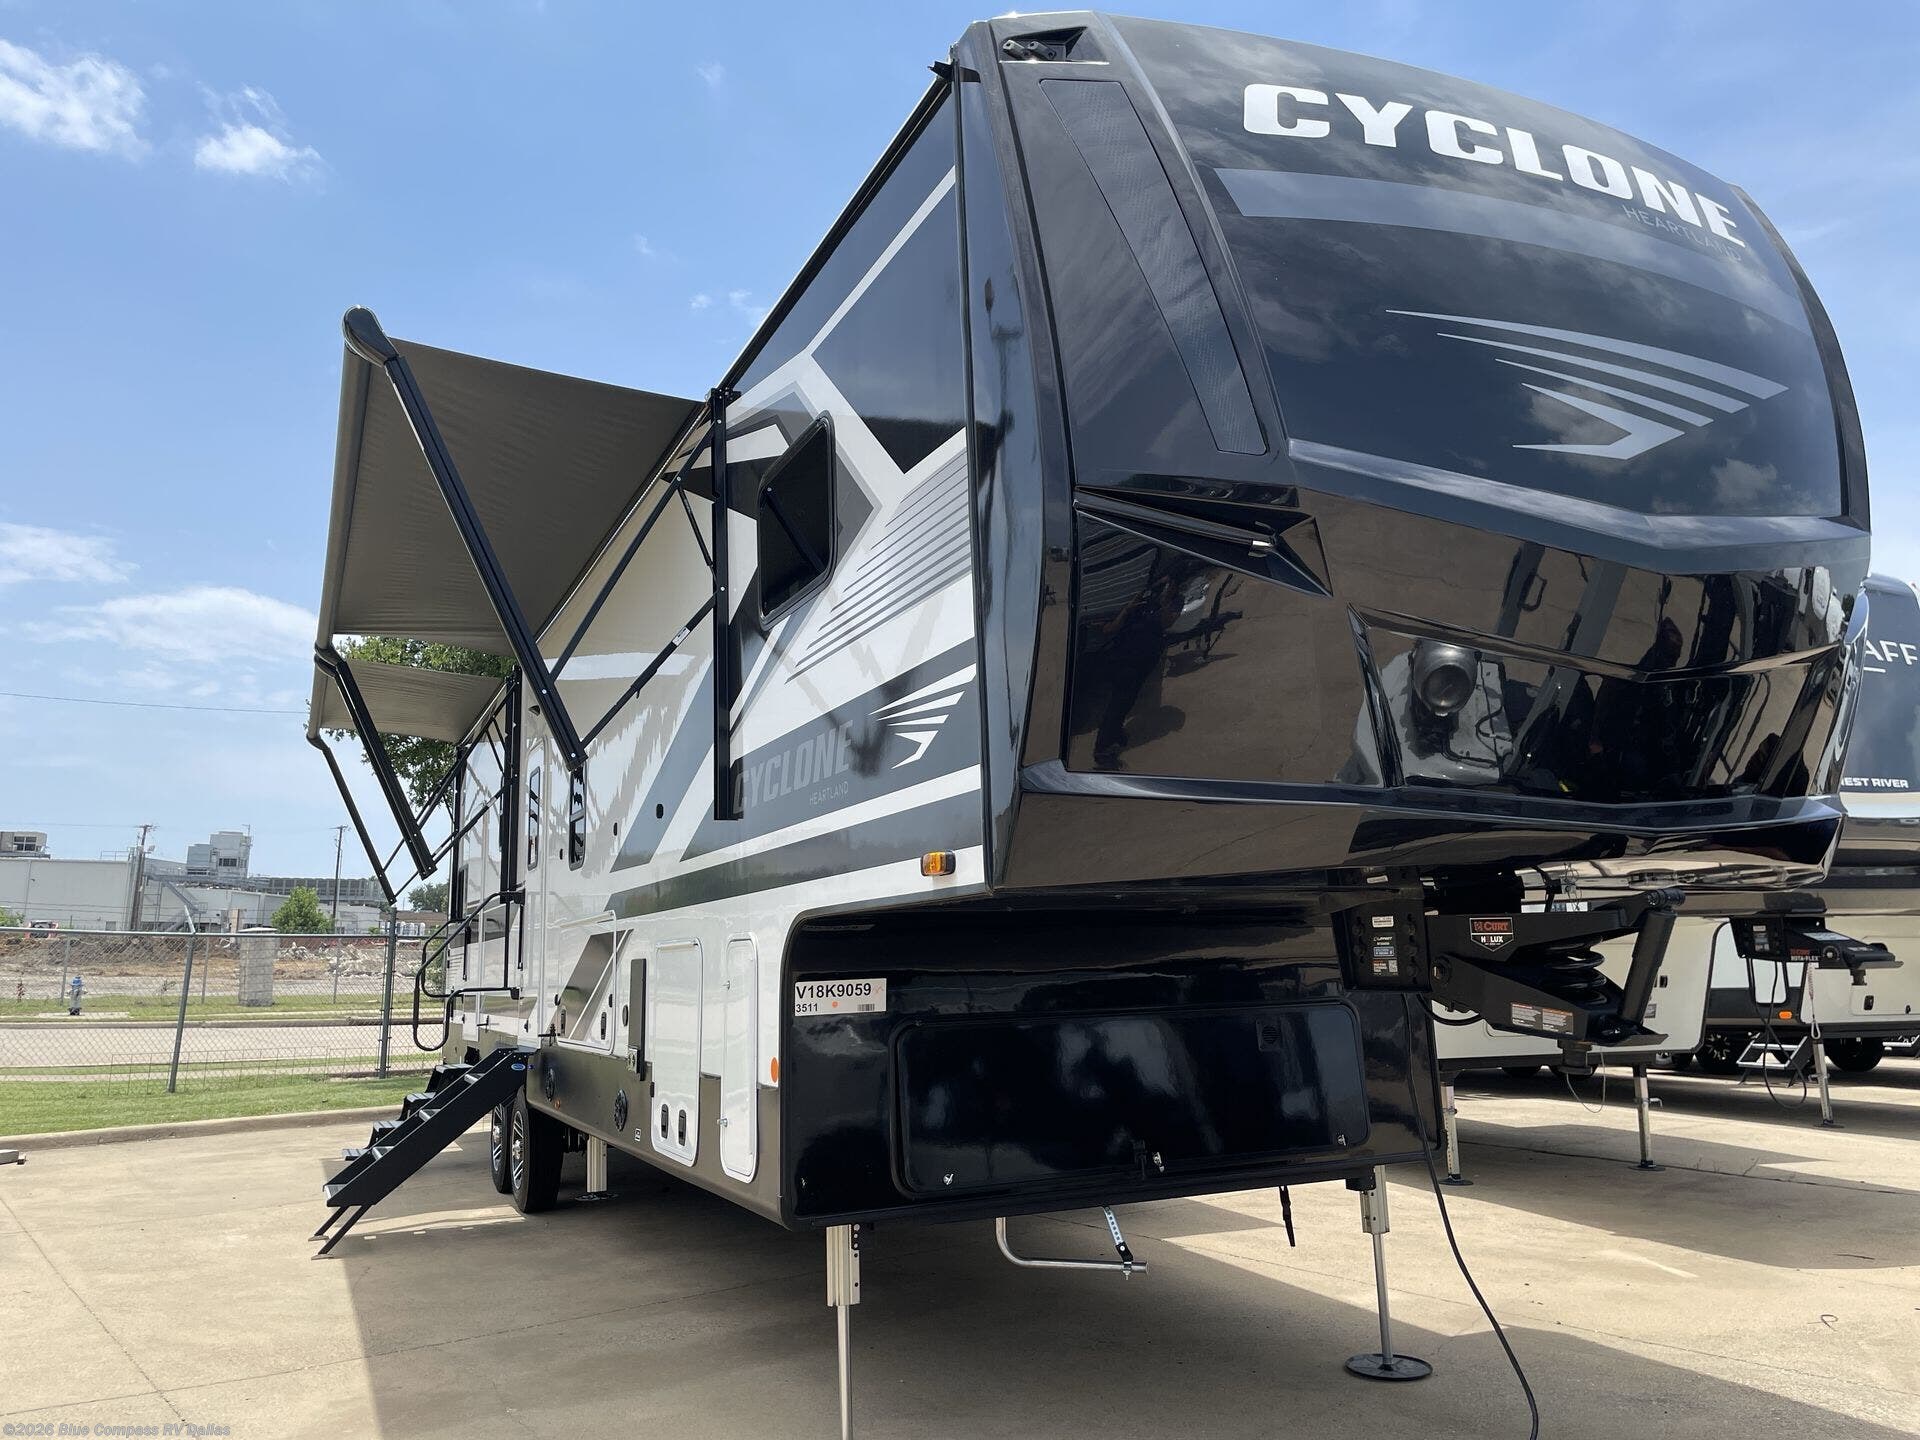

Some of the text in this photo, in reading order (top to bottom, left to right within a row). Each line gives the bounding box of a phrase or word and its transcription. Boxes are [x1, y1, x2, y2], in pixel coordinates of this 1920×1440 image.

[1243, 83, 1746, 248] CYCLONE
[1622, 203, 1742, 263] HEARTLAND
[732, 719, 854, 816] CYCLONE
[809, 781, 850, 806] HEARTLAND
[1870, 777, 1909, 788] RIVER
[796, 982, 872, 999] V18K9059
[795, 1003, 818, 1013] 3511
